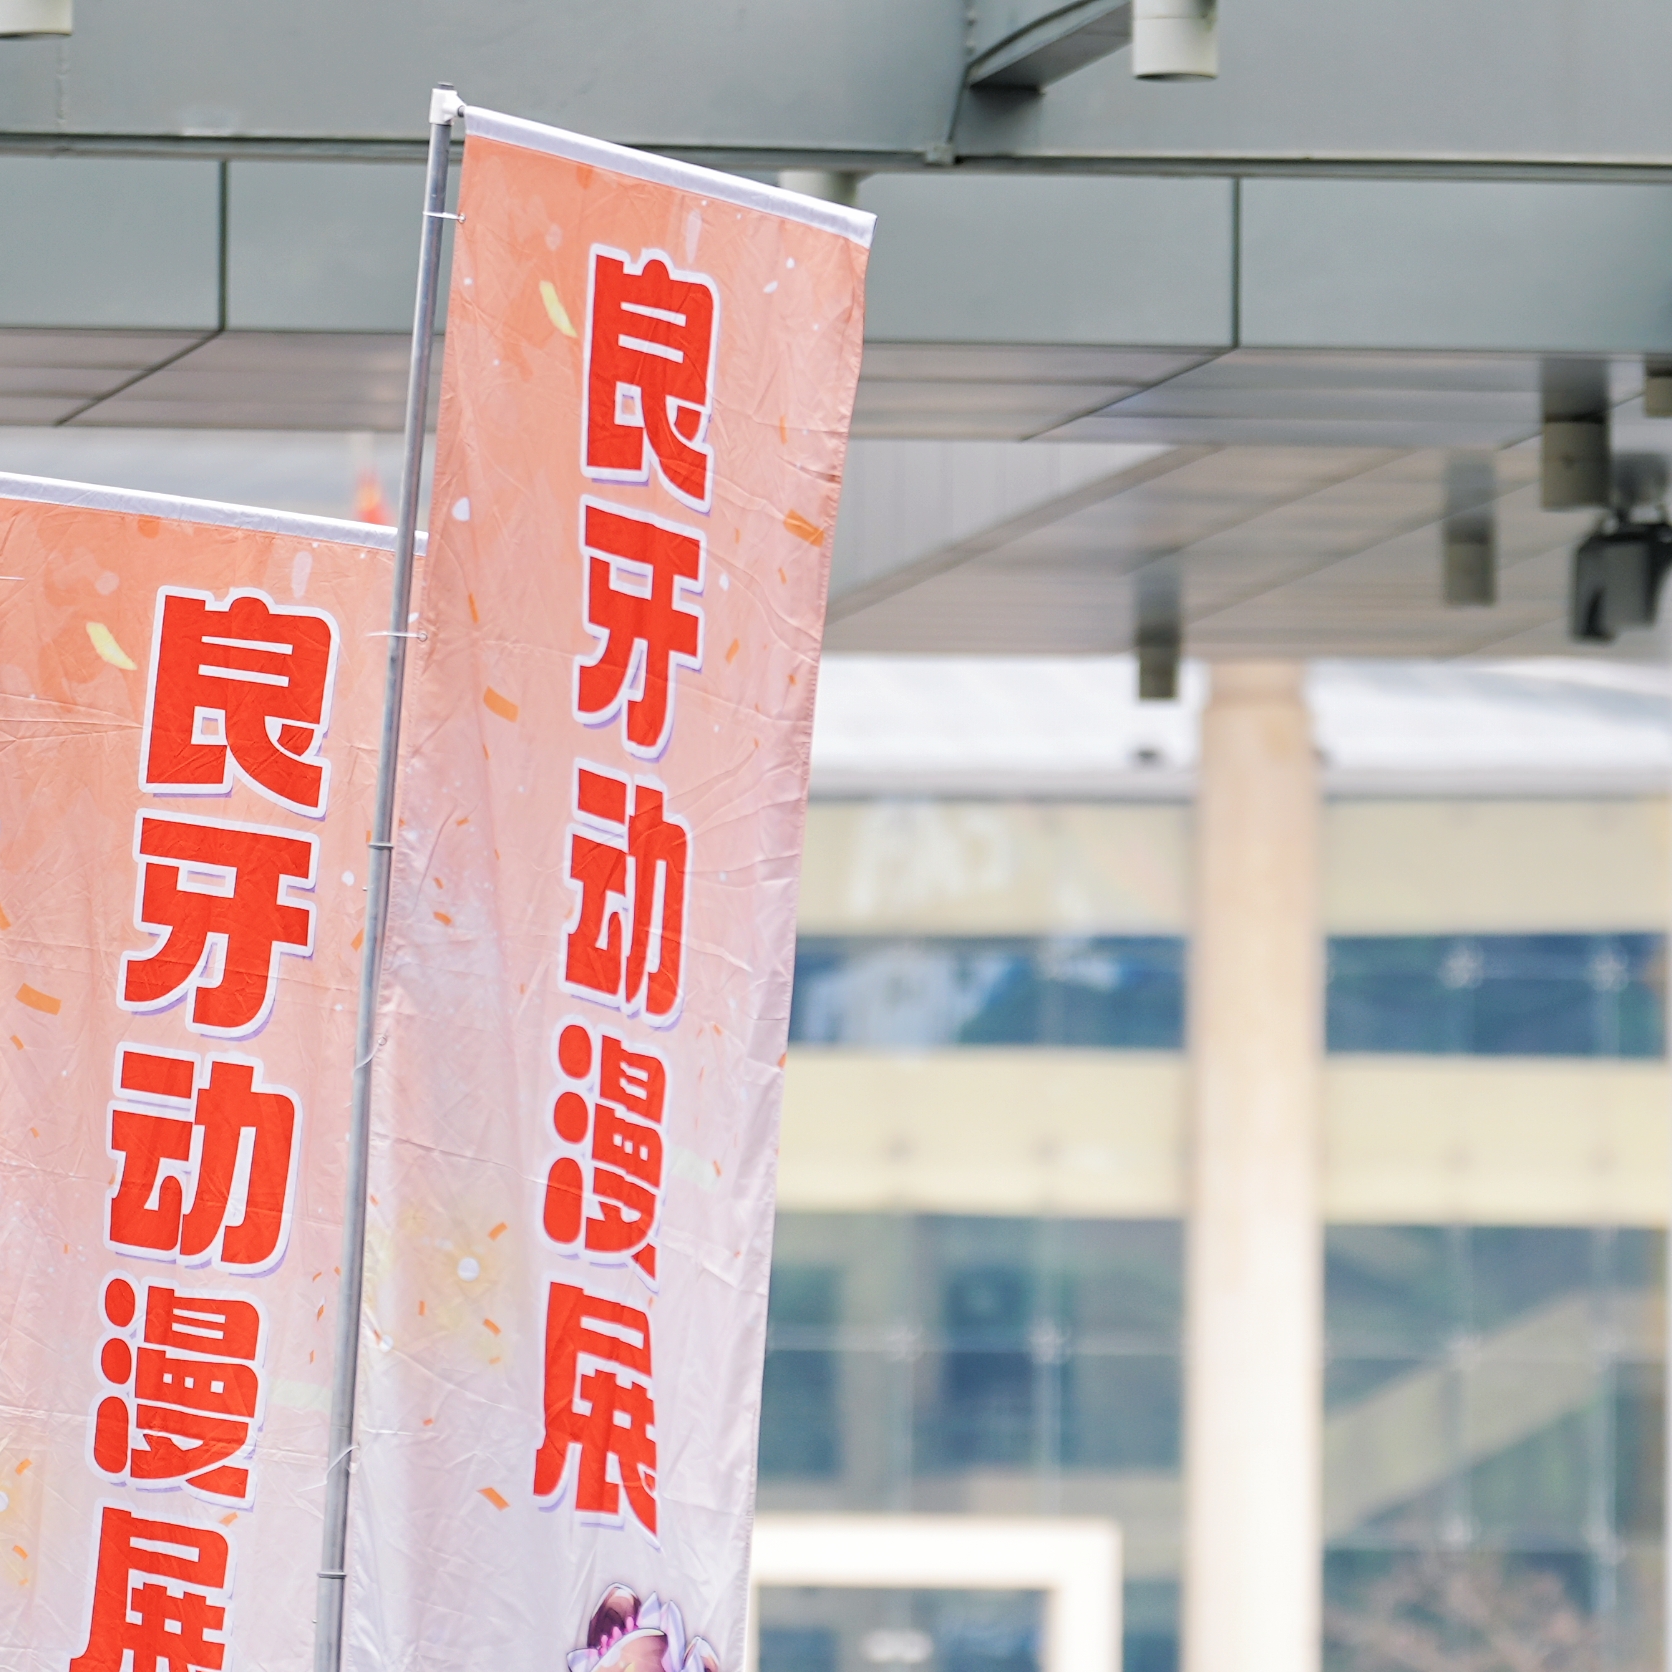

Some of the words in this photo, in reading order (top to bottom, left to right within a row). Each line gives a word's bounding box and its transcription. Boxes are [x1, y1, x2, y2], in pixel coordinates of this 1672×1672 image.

[531, 247, 719, 1540] 良牙动漫展
